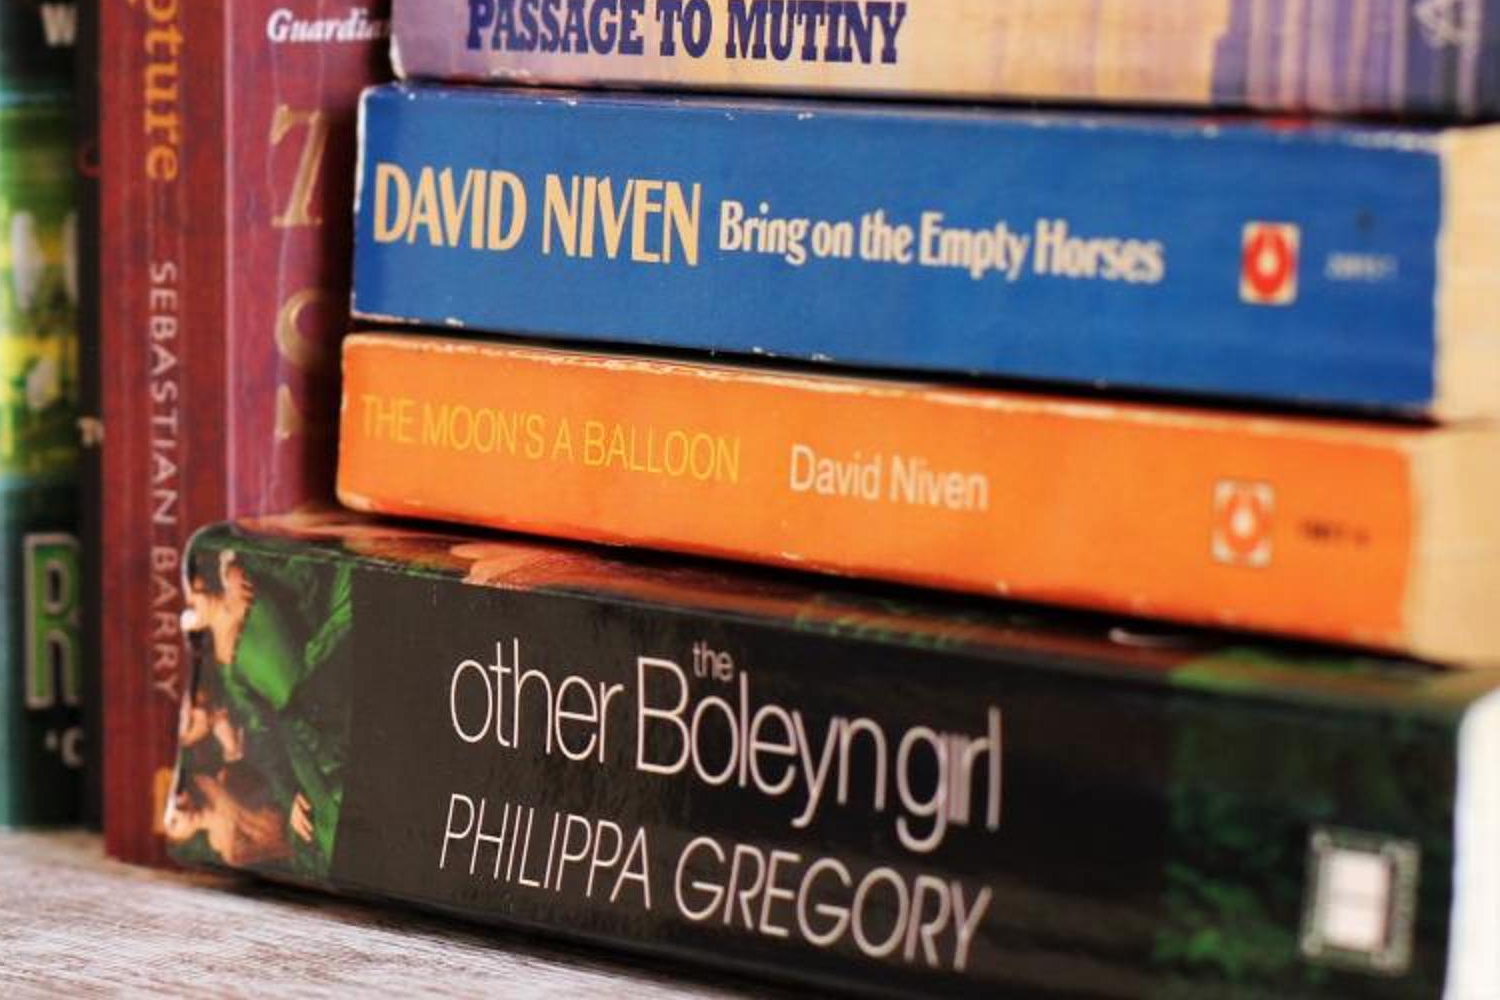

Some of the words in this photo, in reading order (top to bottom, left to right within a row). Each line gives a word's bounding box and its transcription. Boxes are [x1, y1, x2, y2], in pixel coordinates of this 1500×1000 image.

[373, 163, 527, 251] DAVID
[543, 174, 702, 266] NIVEN
[720, 200, 807, 265] Bring
[812, 220, 853, 259] on
[860, 210, 912, 264] the
[919, 212, 1027, 282] Empty
[1034, 219, 1164, 283] Horses
[148, 260, 181, 526] SEBASTIAN
[362, 395, 414, 444] THE
[421, 404, 547, 461] MOON'S
[550, 414, 574, 463] A
[582, 420, 740, 483] BALLOON
[789, 445, 882, 500] David
[889, 455, 989, 512] Niven
[148, 547, 184, 701] BARRY
[692, 640, 734, 681] the
[449, 638, 623, 764] other
[636, 656, 885, 830] Boleyn
[438, 792, 653, 909] PHILIPPA
[674, 834, 991, 972] GREGORY
